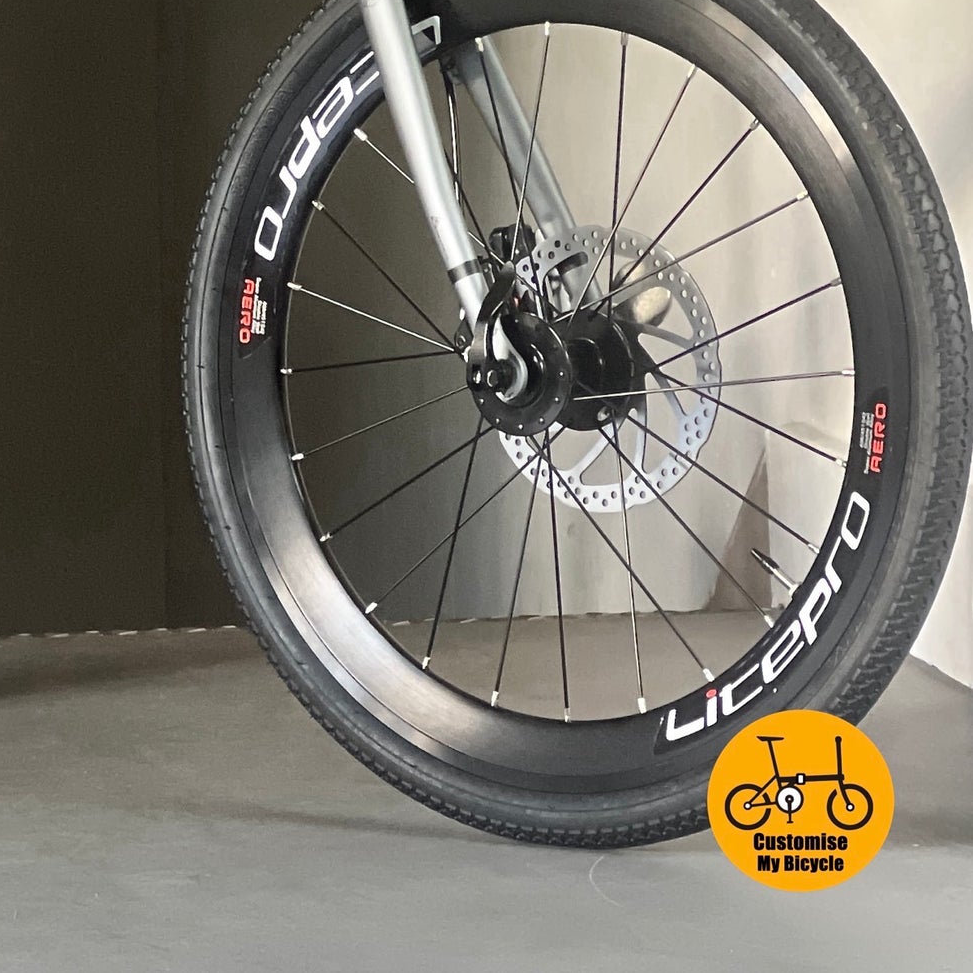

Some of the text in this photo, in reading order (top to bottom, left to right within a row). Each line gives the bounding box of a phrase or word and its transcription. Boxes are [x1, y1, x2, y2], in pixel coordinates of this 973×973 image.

[239, 278, 256, 344] AERO
[870, 403, 887, 473] AERO
[666, 491, 870, 741] Litepro
